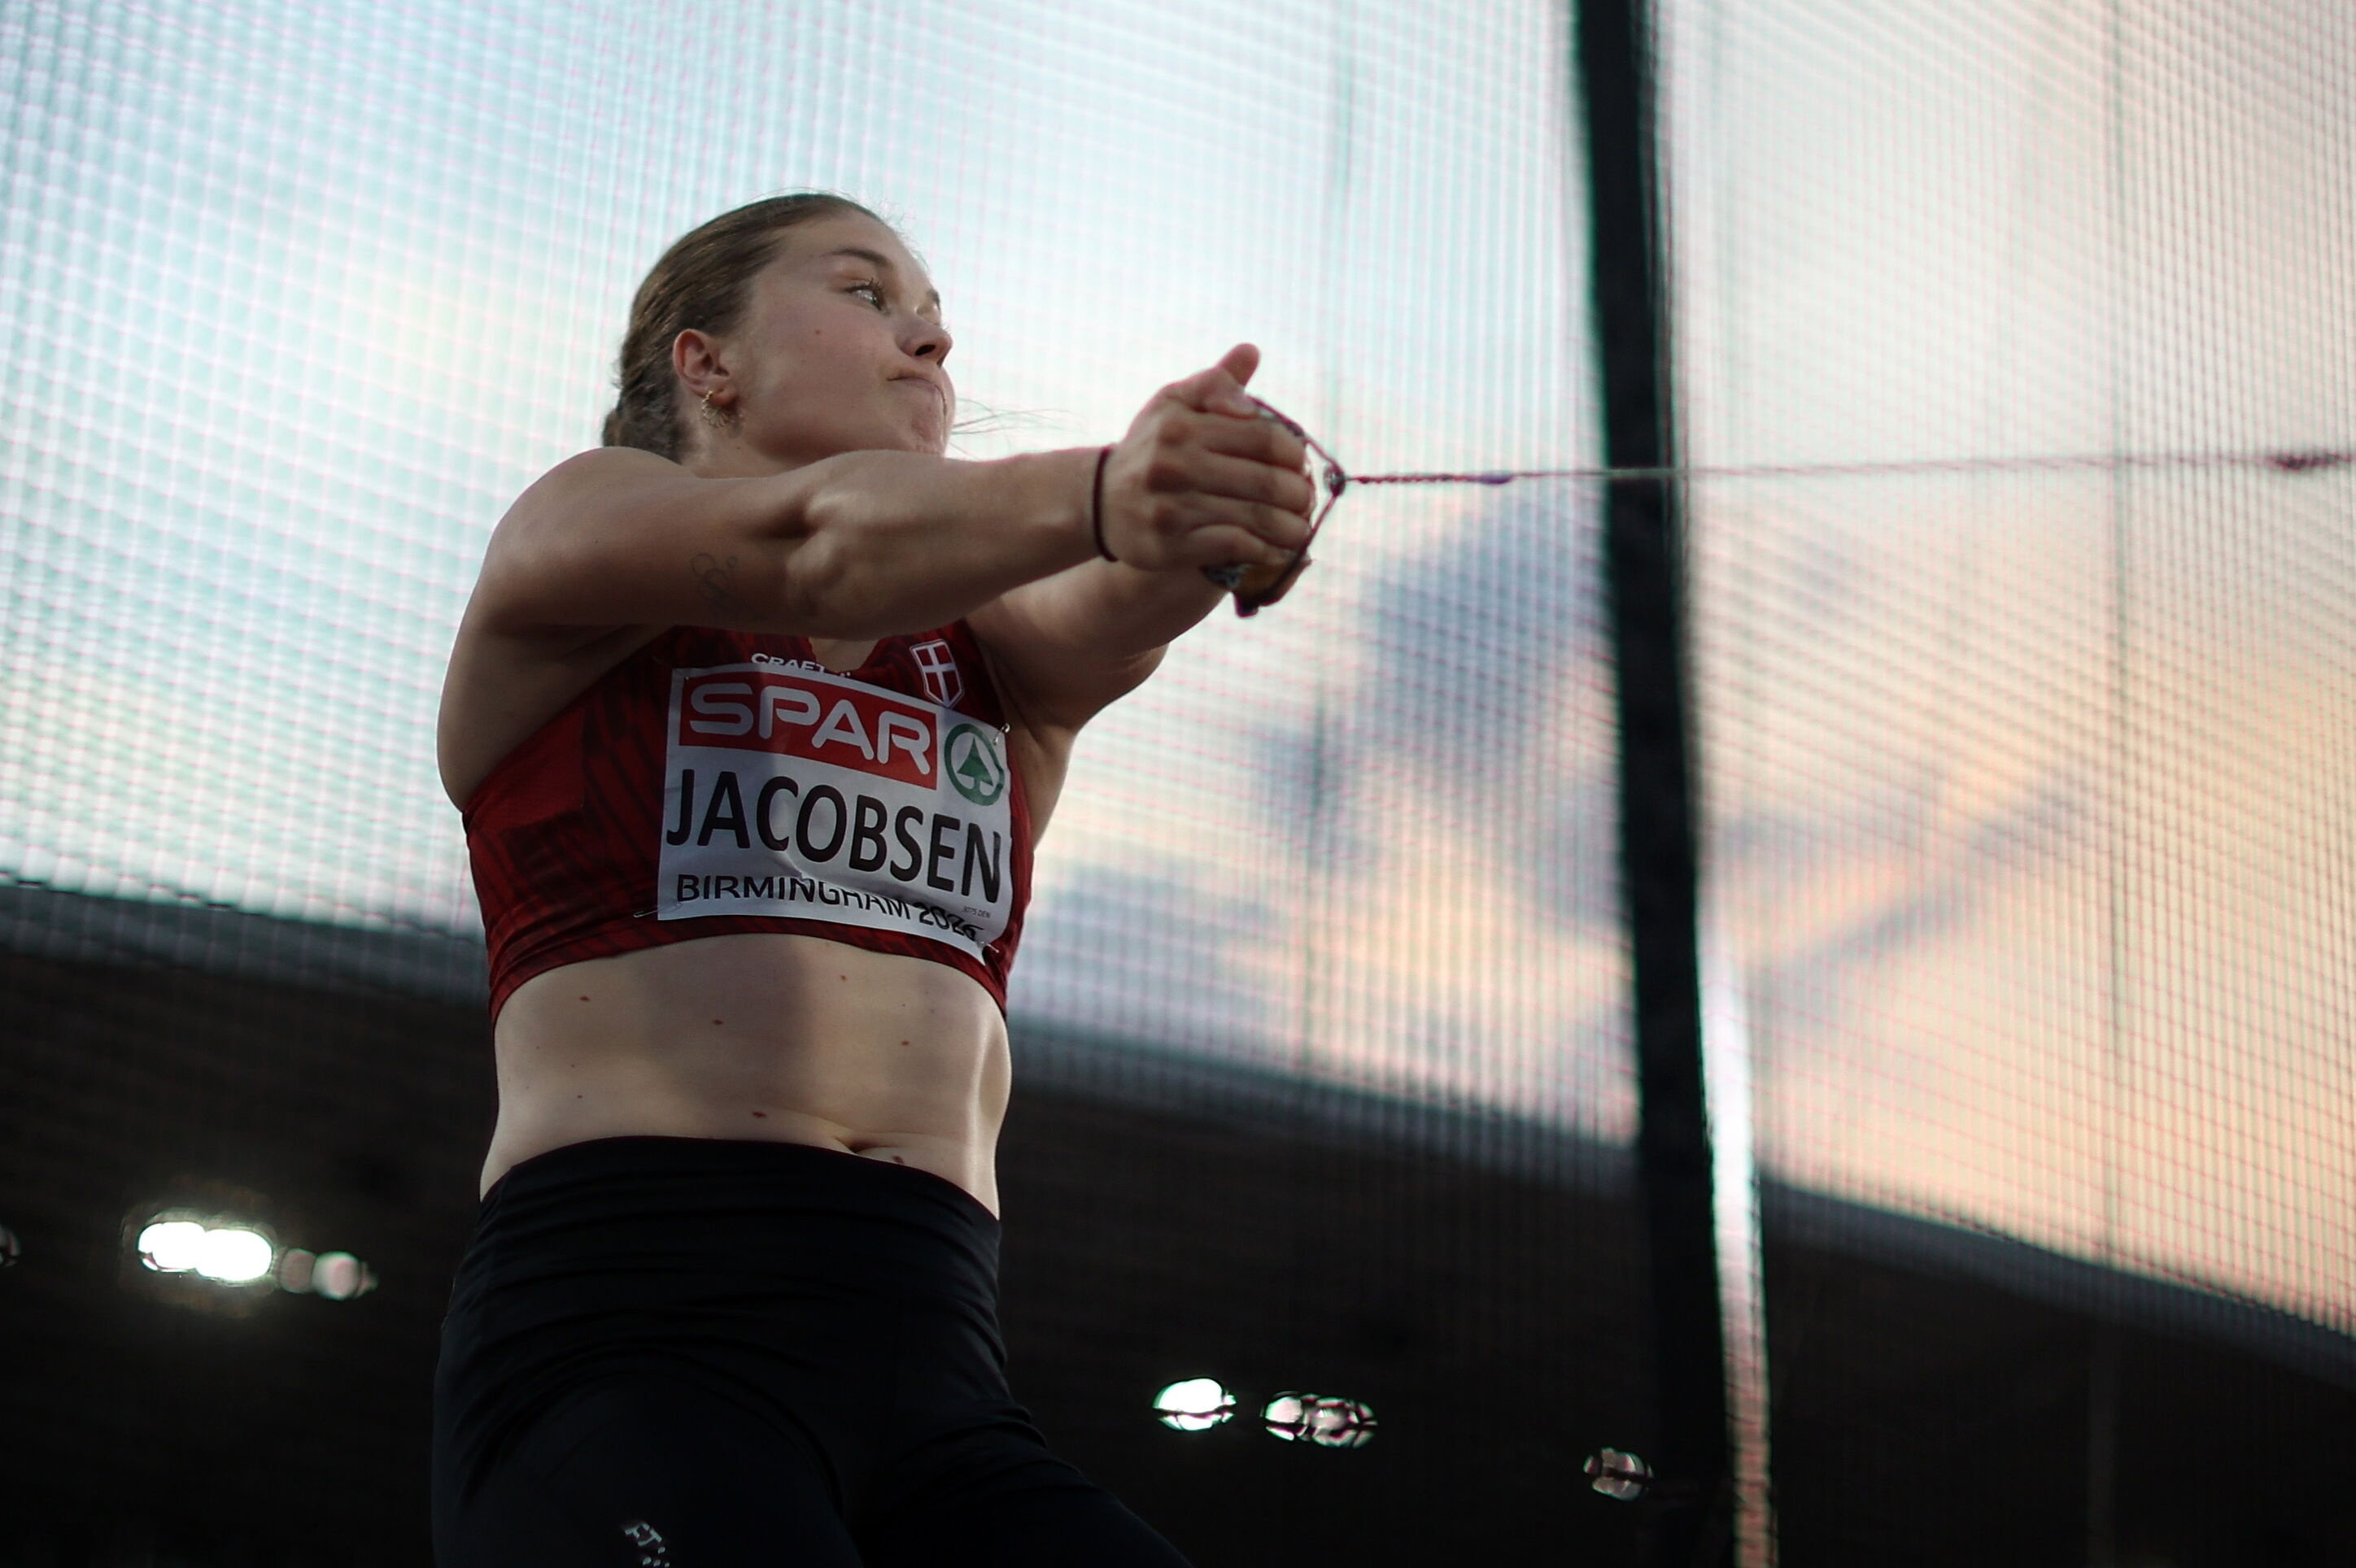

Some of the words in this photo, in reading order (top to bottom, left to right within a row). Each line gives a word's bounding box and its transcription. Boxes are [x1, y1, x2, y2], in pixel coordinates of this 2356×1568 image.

[689, 682, 931, 775] SPAR
[666, 769, 1001, 904] JACOBSEN
[677, 873, 911, 920] BIRMINGHAM
[913, 901, 984, 941] 2026
